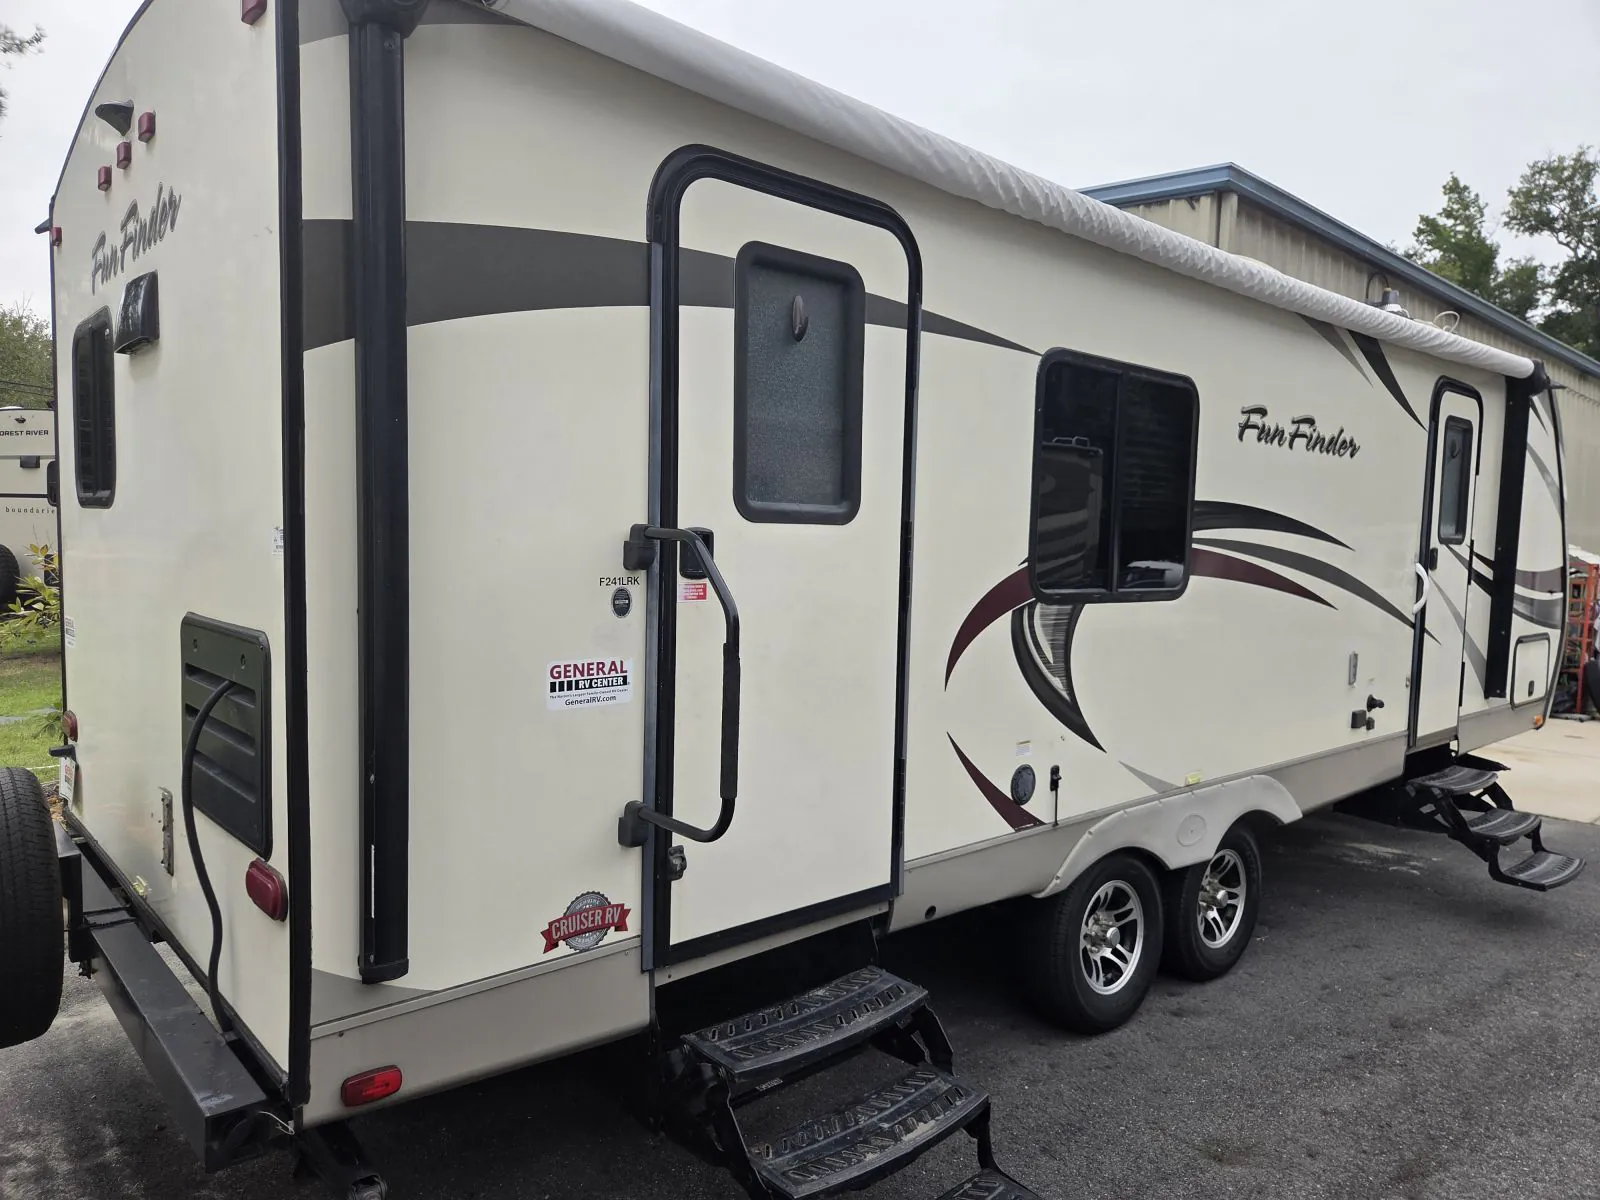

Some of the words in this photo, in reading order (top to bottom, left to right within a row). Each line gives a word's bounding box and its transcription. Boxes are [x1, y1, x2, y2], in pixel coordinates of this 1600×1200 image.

[599, 576, 640, 587] F241LRK
[549, 660, 628, 680] GENERAL
[578, 679, 591, 689] RV
[591, 676, 624, 688] CENTER
[564, 695, 617, 706] GeneralRV.com
[551, 909, 603, 940] CRUISER
[604, 906, 621, 924] RV
